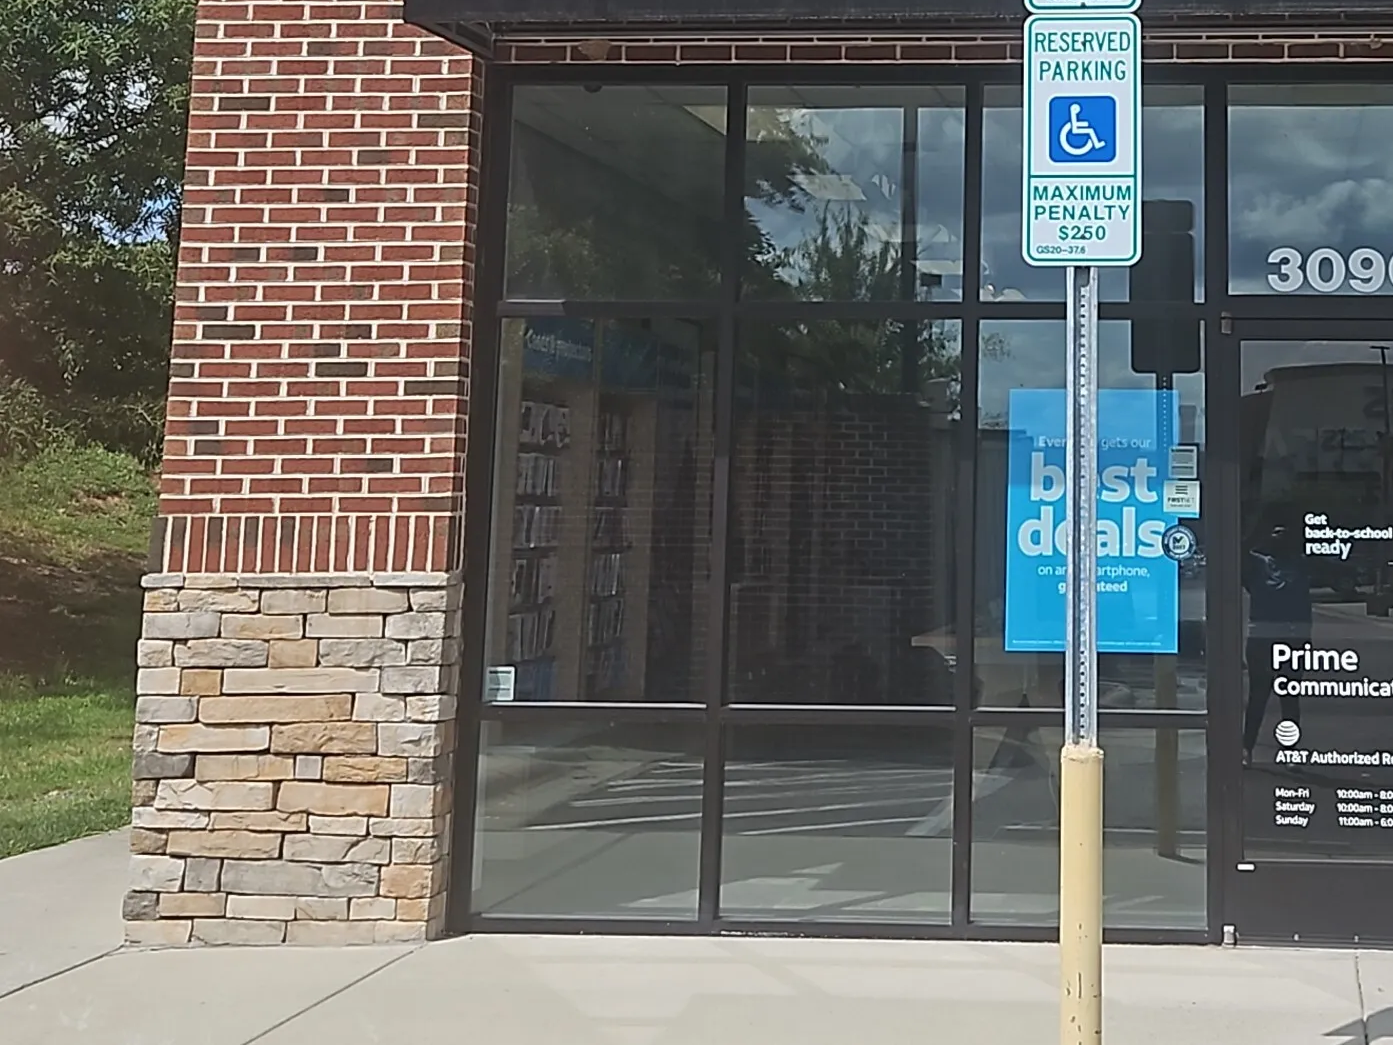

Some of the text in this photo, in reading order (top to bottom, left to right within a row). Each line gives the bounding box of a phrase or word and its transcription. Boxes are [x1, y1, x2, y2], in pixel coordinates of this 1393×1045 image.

[1034, 32, 1131, 53] RESERVED
[1039, 60, 1126, 81] PARKING
[1033, 185, 1131, 201] MAXIMUM
[1034, 205, 1130, 221] PENALTY
[1058, 225, 1106, 242] $250
[1101, 436, 1127, 451] gets
[1130, 437, 1151, 448] our
[1030, 451, 1158, 503] bst
[1305, 513, 1327, 525] Get
[1305, 527, 1393, 539] back-to-school
[1305, 541, 1351, 560] ready
[1038, 566, 1053, 575] on
[1096, 565, 1150, 579] artphone,
[1272, 644, 1359, 671] Prime
[1275, 752, 1308, 764] AT&T
[1311, 751, 1380, 765] Authorized
[1275, 788, 1309, 798] Mon-Fri
[1336, 789, 1373, 799] 10:00am
[1275, 801, 1315, 814] Saturday
[1337, 803, 1373, 813] 10:00am
[1275, 815, 1308, 827] Sunday
[1338, 817, 1373, 827] 11:00am
